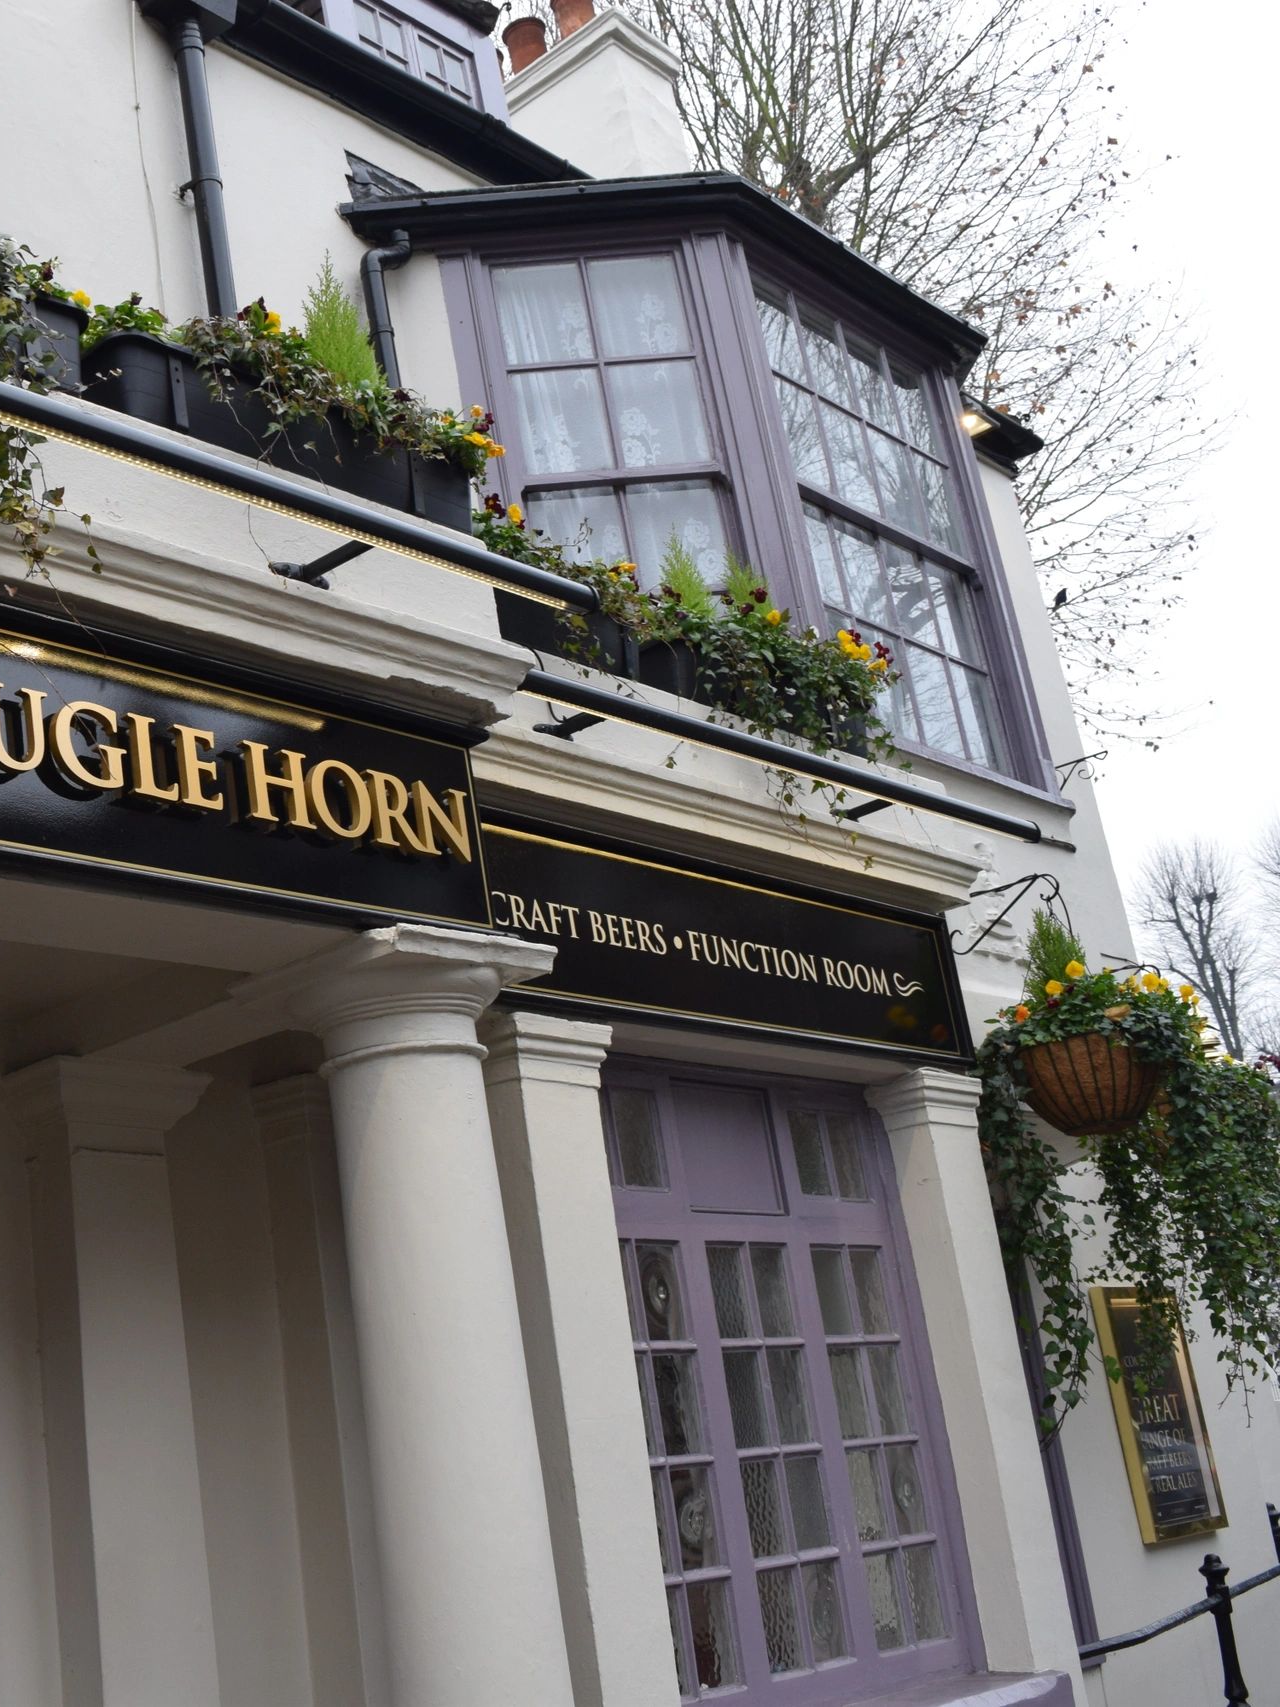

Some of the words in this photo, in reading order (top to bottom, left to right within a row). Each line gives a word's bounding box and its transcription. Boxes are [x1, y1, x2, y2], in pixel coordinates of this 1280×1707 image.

[238, 738, 474, 863] HORN
[491, 891, 580, 939] CRAFT
[587, 910, 668, 955] BEERS
[686, 930, 818, 983] FUNCTION
[821, 956, 892, 996] ROOM
